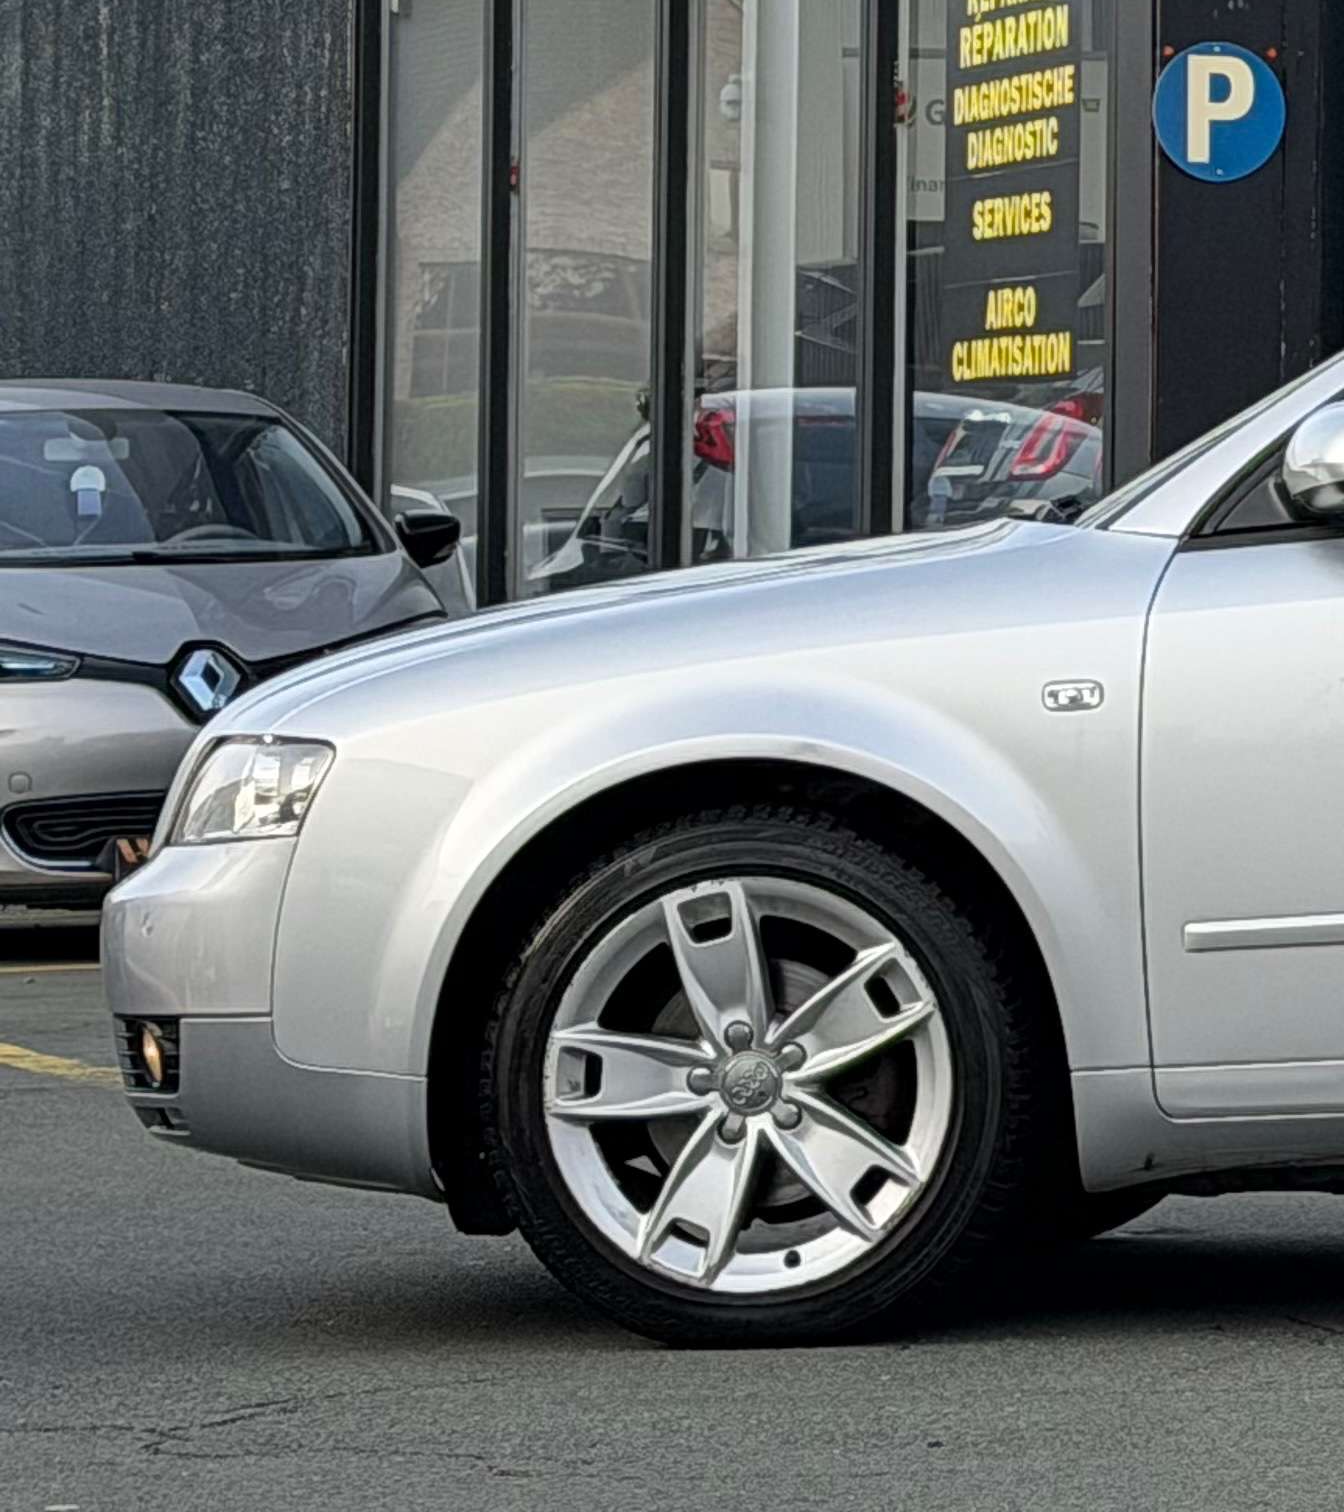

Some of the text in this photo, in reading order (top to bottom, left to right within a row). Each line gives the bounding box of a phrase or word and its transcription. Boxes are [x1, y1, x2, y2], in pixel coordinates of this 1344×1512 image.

[959, 3, 1069, 69] RÉPARATION
[953, 64, 1075, 126] DIAGNOSTISCHE
[1186, 53, 1255, 165] P
[967, 116, 1059, 170] DIAGNOSTIC
[972, 191, 1052, 241] SERVICES
[985, 286, 1036, 331] AIRCO
[952, 331, 1071, 383] CLIMATISATION
